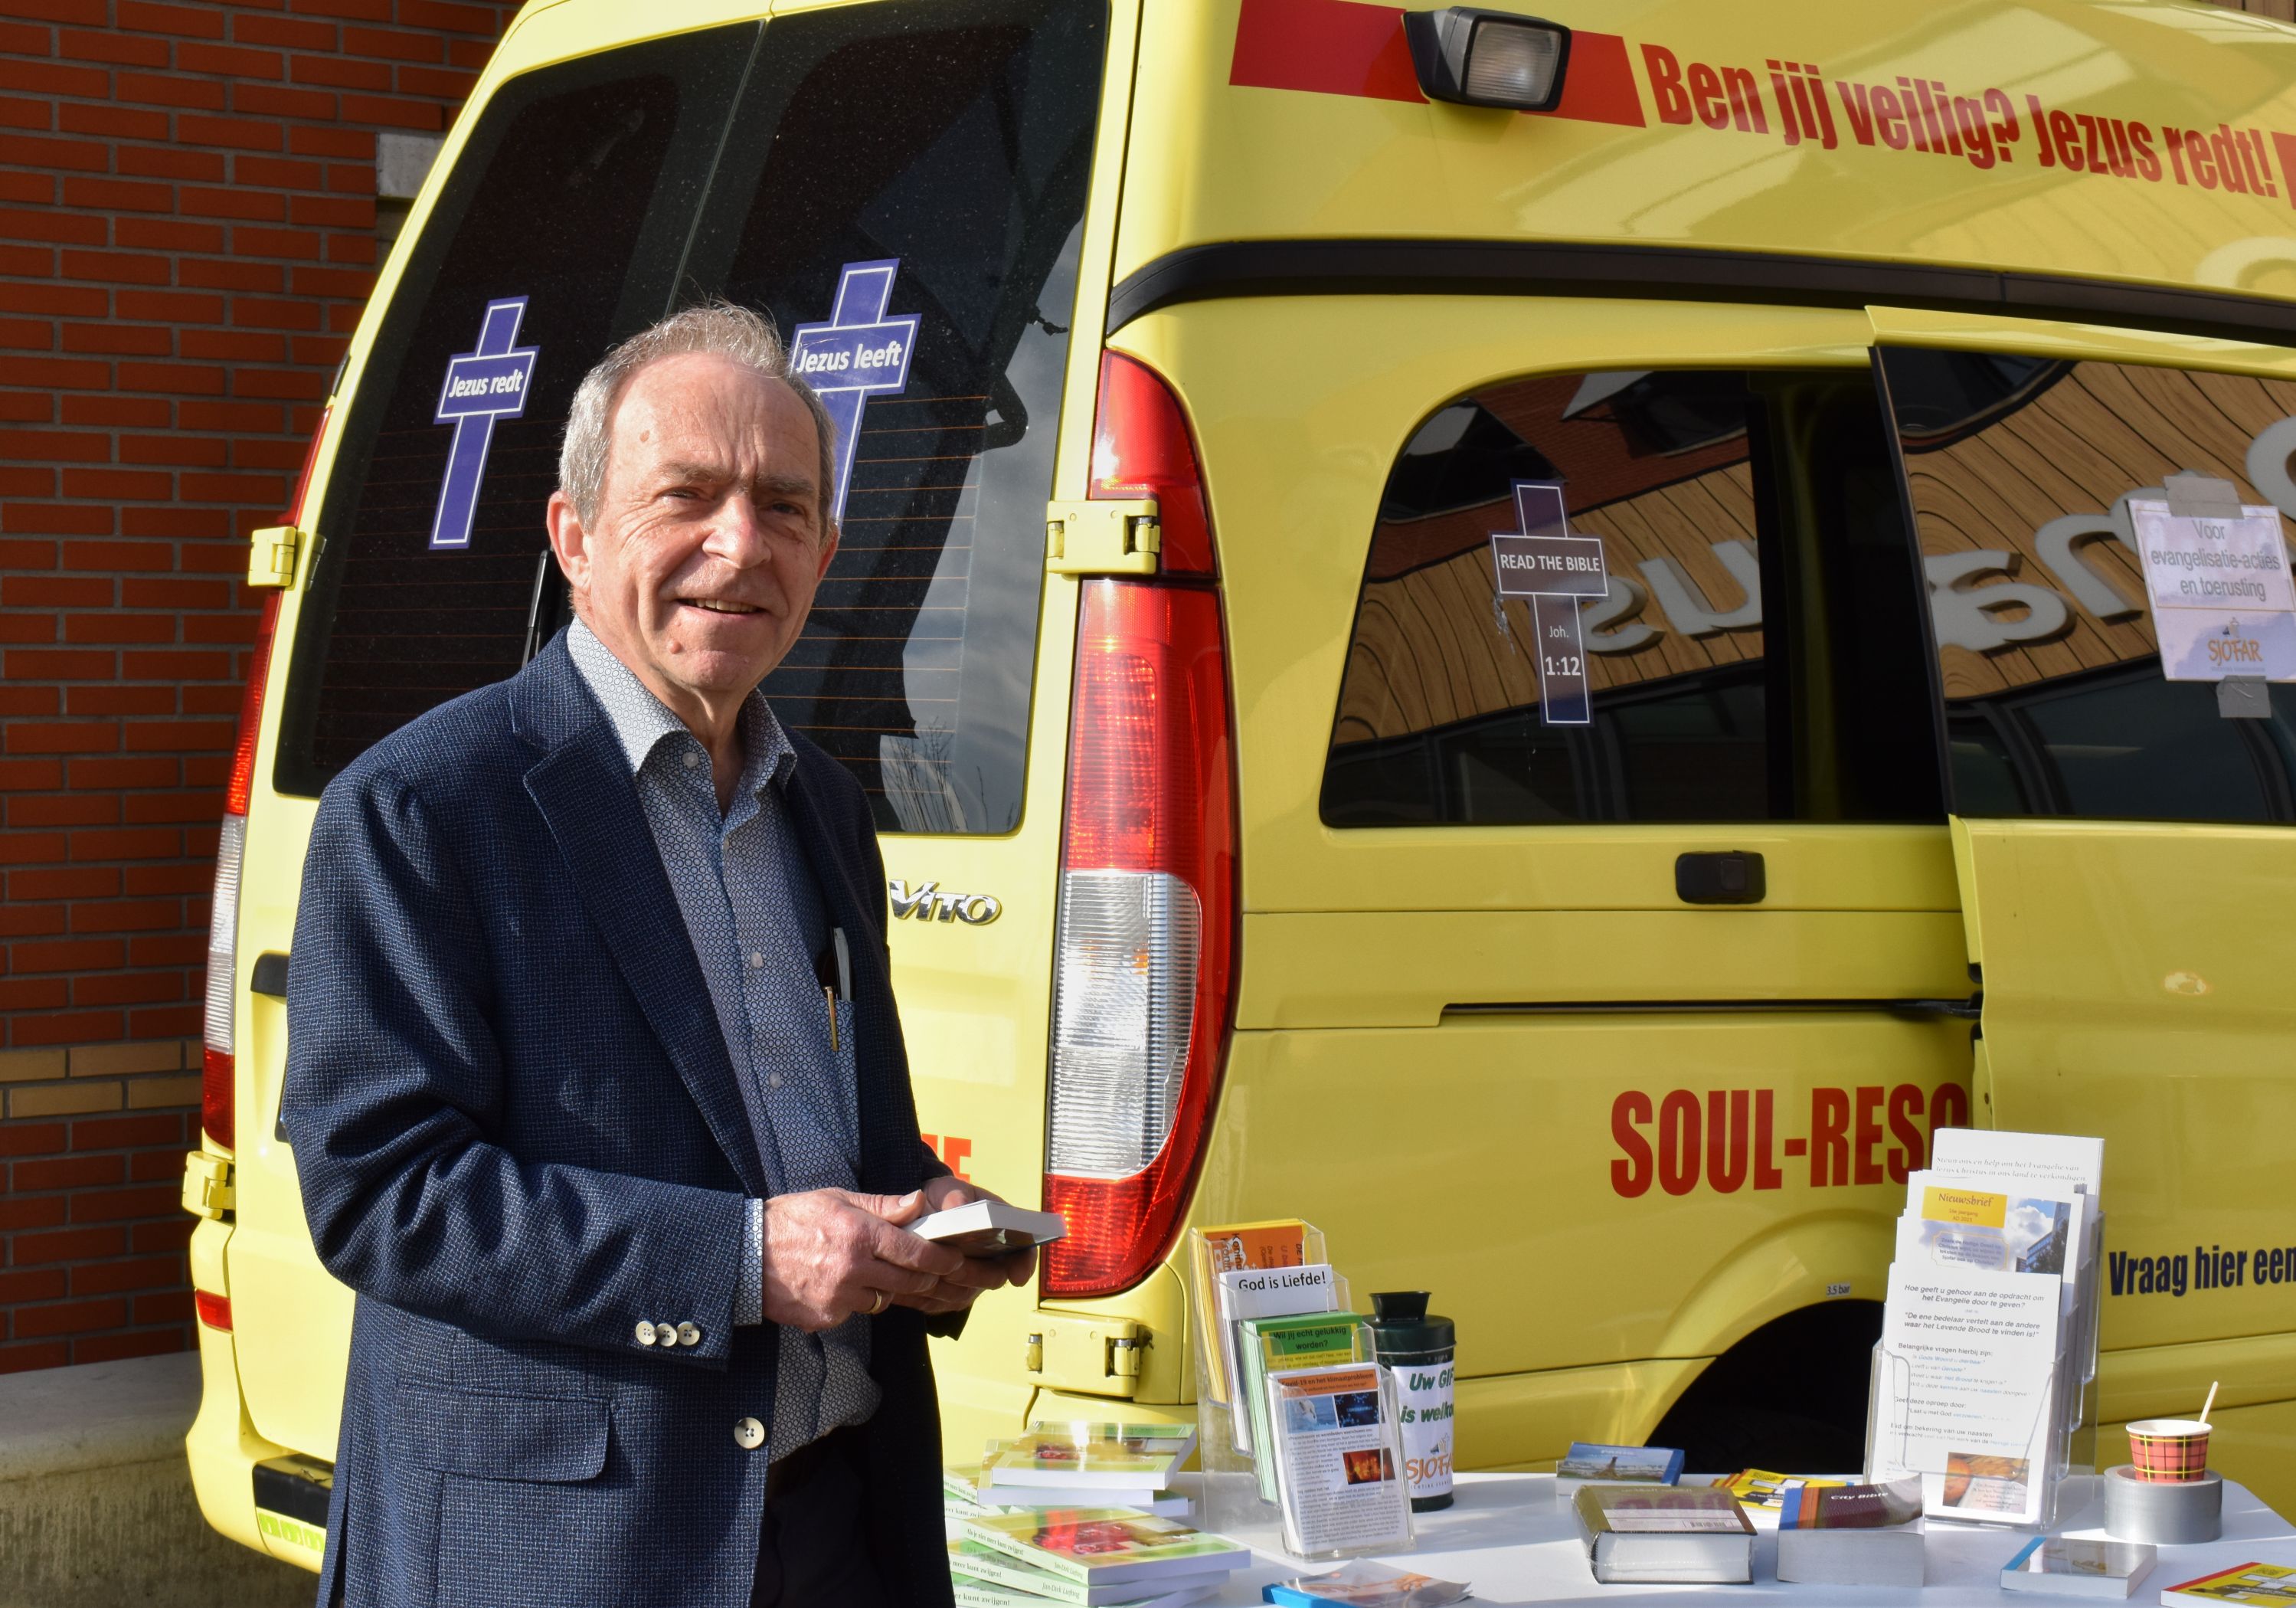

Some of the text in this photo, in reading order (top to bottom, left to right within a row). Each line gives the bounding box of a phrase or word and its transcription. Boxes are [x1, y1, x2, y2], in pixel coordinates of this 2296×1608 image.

[1640, 43, 2278, 198] Ben jij veilig? Jezus redt!
[797, 341, 903, 374] Jezus leeft
[449, 369, 522, 398] Jezus redt
[2192, 519, 2226, 540] Voor
[1500, 554, 1601, 571] READ THE BIBLE
[2151, 549, 2281, 571] evangelisatie-acties
[2180, 577, 2266, 602] en toerusting
[1549, 625, 1569, 638] Joh.
[2207, 638, 2263, 666] SJOFAR
[1545, 656, 1581, 676] 1:12
[1939, 1192, 1994, 1207] Nieuwsbrief
[2108, 1251, 2188, 1297] Vraag
[2194, 1245, 2247, 1290] hier
[1238, 1271, 1326, 1292] God is Liefde!
[1838, 1284, 1851, 1295] bar
[1935, 1295, 1971, 1305] Evangelie
[1934, 1315, 1964, 1323] bedelaar
[1936, 1323, 1966, 1332] Levende
[1274, 1326, 1346, 1340] Wil jij echt gelukkig
[1296, 1340, 1329, 1350] worden?
[1899, 1342, 1934, 1352] Belangrijke
[1958, 1348, 1978, 1357] hierbij
[1410, 1373, 1435, 1391] Uw
[1925, 1400, 1948, 1408] oproep
[1401, 1405, 1416, 1424] is
[1915, 1425, 1942, 1434] bekering
[967, 1562, 979, 1572] kunt
[981, 1568, 1002, 1579] zwijgen!
[963, 1593, 1011, 1606] kunt zwijgen!
